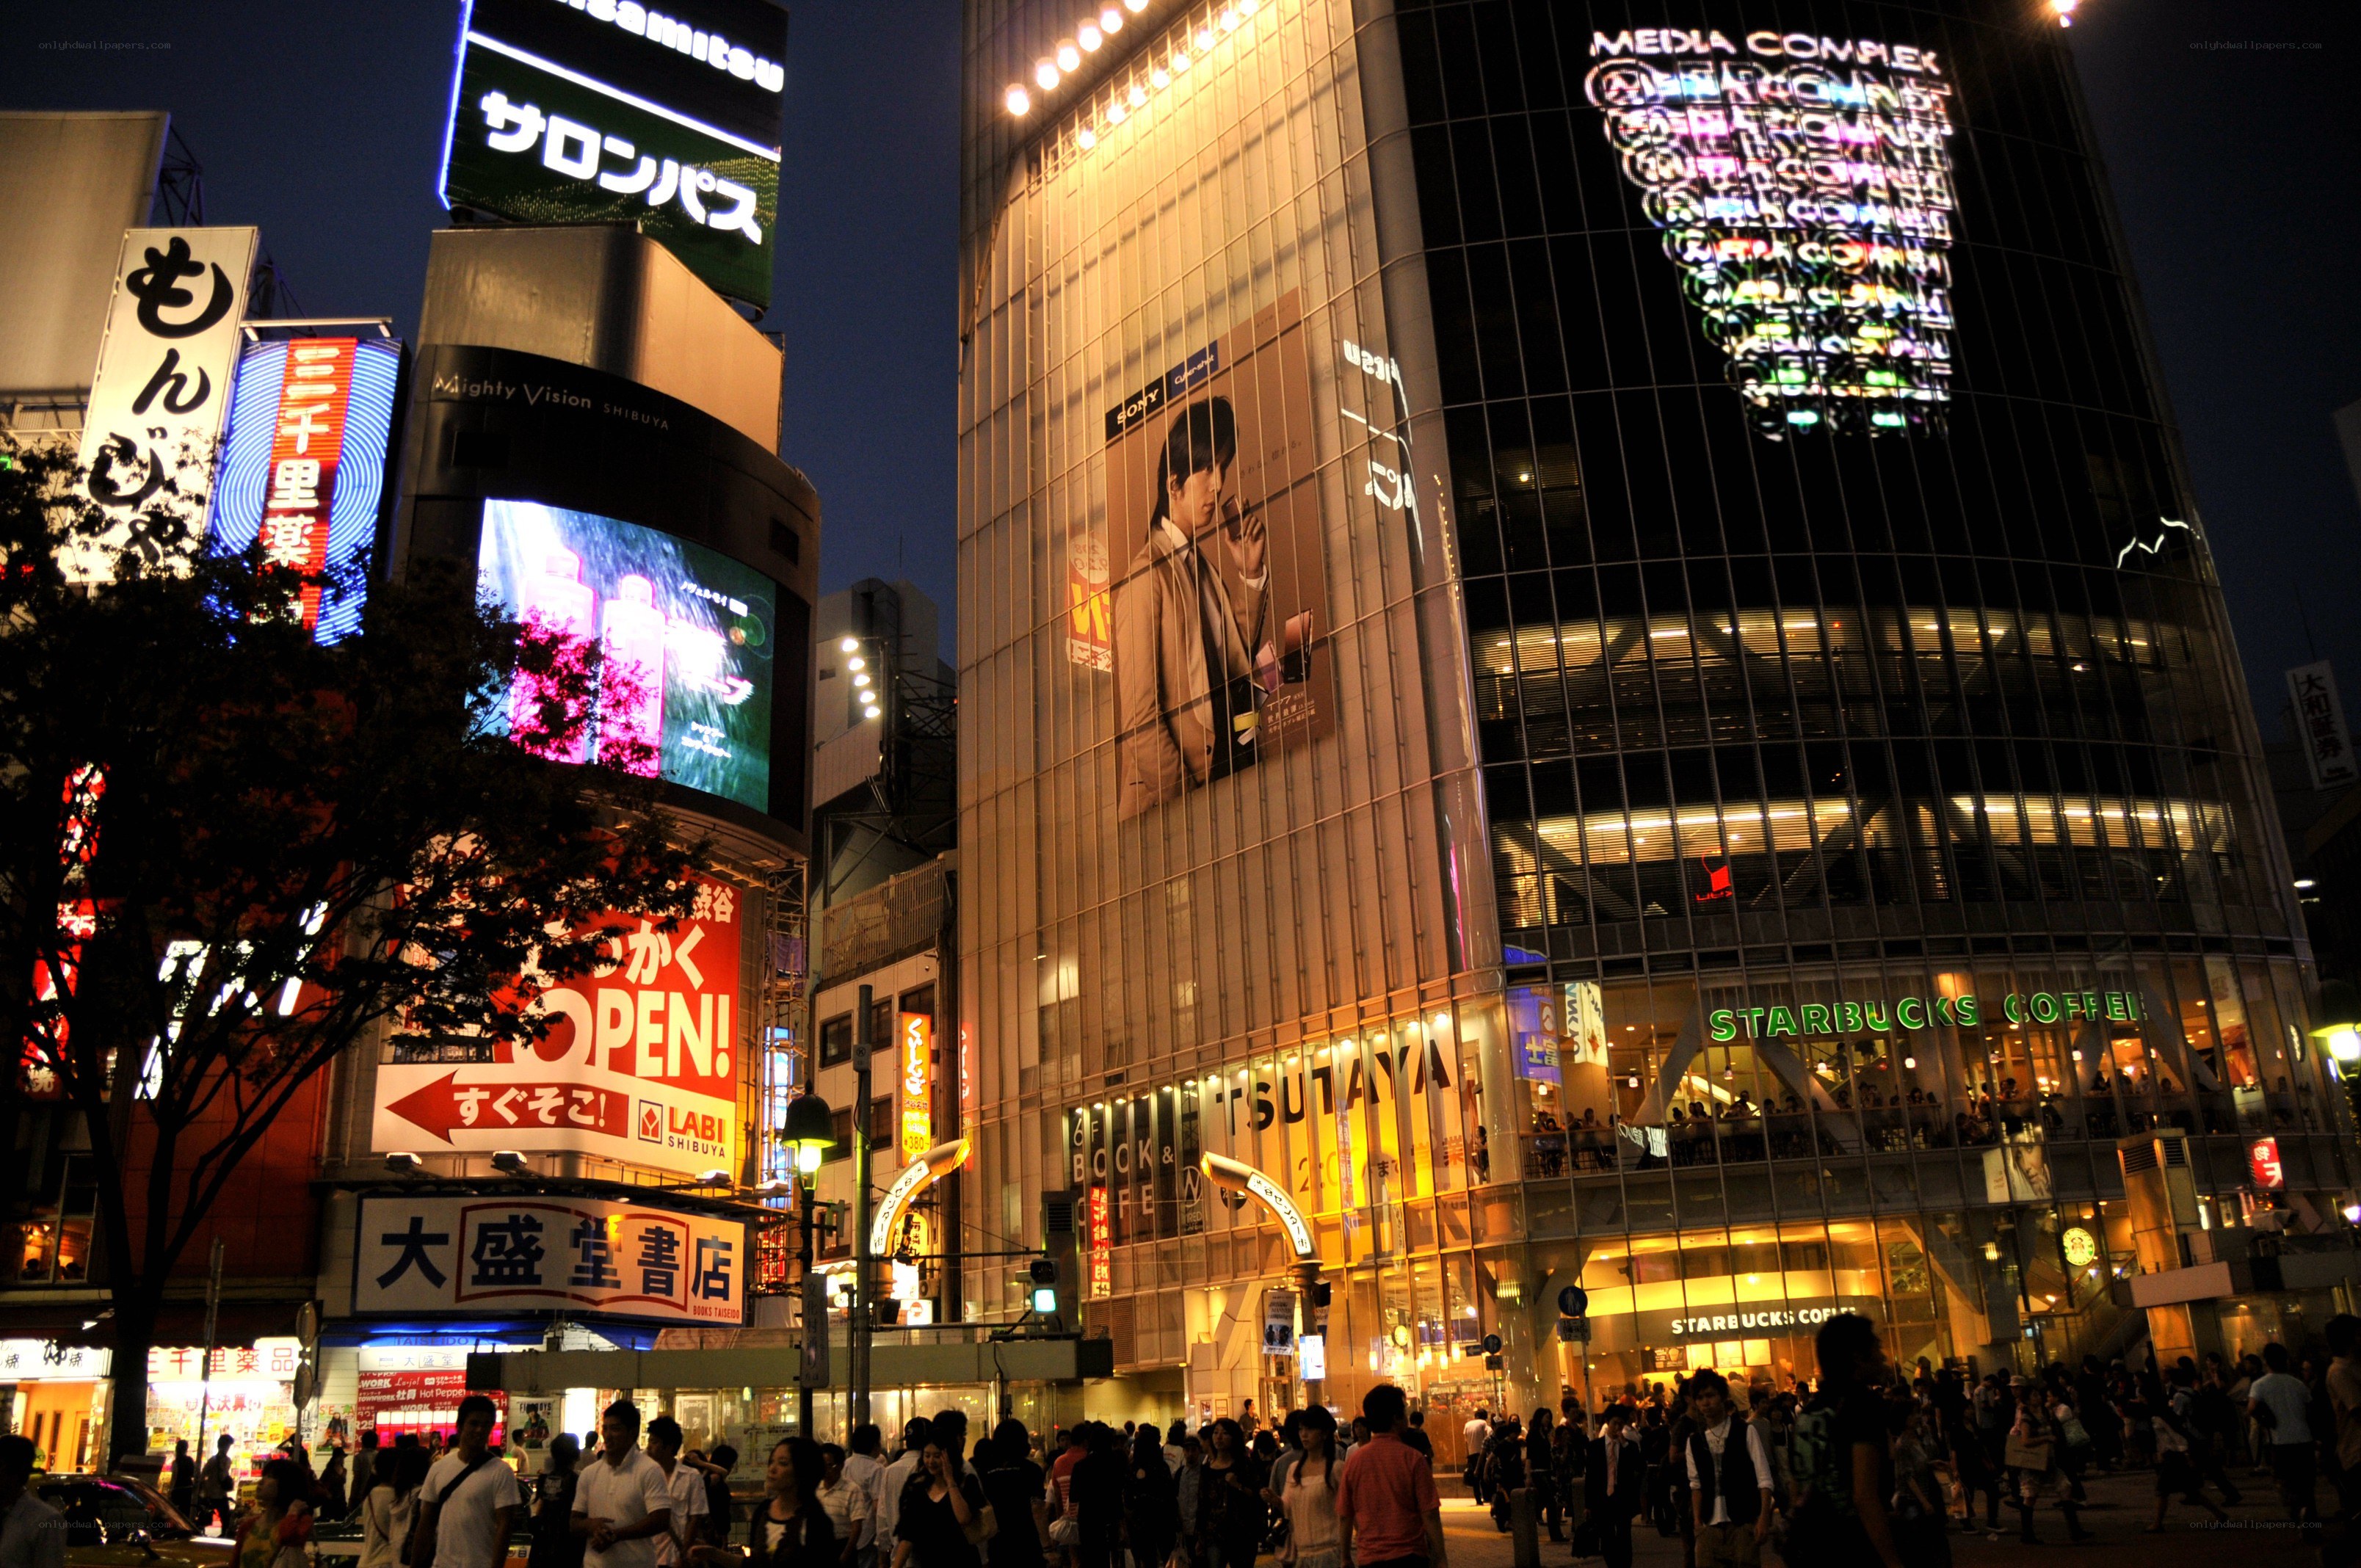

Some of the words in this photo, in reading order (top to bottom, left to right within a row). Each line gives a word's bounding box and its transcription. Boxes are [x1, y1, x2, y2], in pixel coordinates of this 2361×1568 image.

[554, 0, 784, 92] samitsu
[1590, 29, 1737, 57] MEDIA
[1745, 32, 1941, 76] COMPLEX
[481, 91, 763, 244] サロンパス
[432, 371, 516, 399] Mighty
[523, 384, 592, 407] Vision
[603, 403, 670, 431] SHIBUYA
[1117, 389, 1159, 424] SONY
[512, 988, 730, 1078] OPEN!
[1709, 995, 1979, 1042] STARBUCKS
[2004, 991, 2148, 1025] COFFEE
[452, 1086, 607, 1128] すぐそこ!
[1216, 1039, 1452, 1136] TSUTAYA
[668, 1106, 727, 1142] LABI
[1073, 1117, 1099, 1147] 6F
[668, 1135, 727, 1158] SHIBUYA
[1073, 1138, 1153, 1183] BOOK
[1162, 1145, 1175, 1164] &
[1078, 1184, 1154, 1227] CFE
[1252, 1177, 1308, 1249] 渋谷センター街
[376, 1213, 733, 1302] 大盛堂書店
[692, 1304, 713, 1318] BOOKS
[714, 1307, 741, 1321] TAISEIDO
[1671, 1310, 1794, 1335] STARBUCKS
[395, 1336, 469, 1346] TAISEIDO
[396, 1389, 416, 1401] 社員
[420, 1390, 434, 1398] Hot
